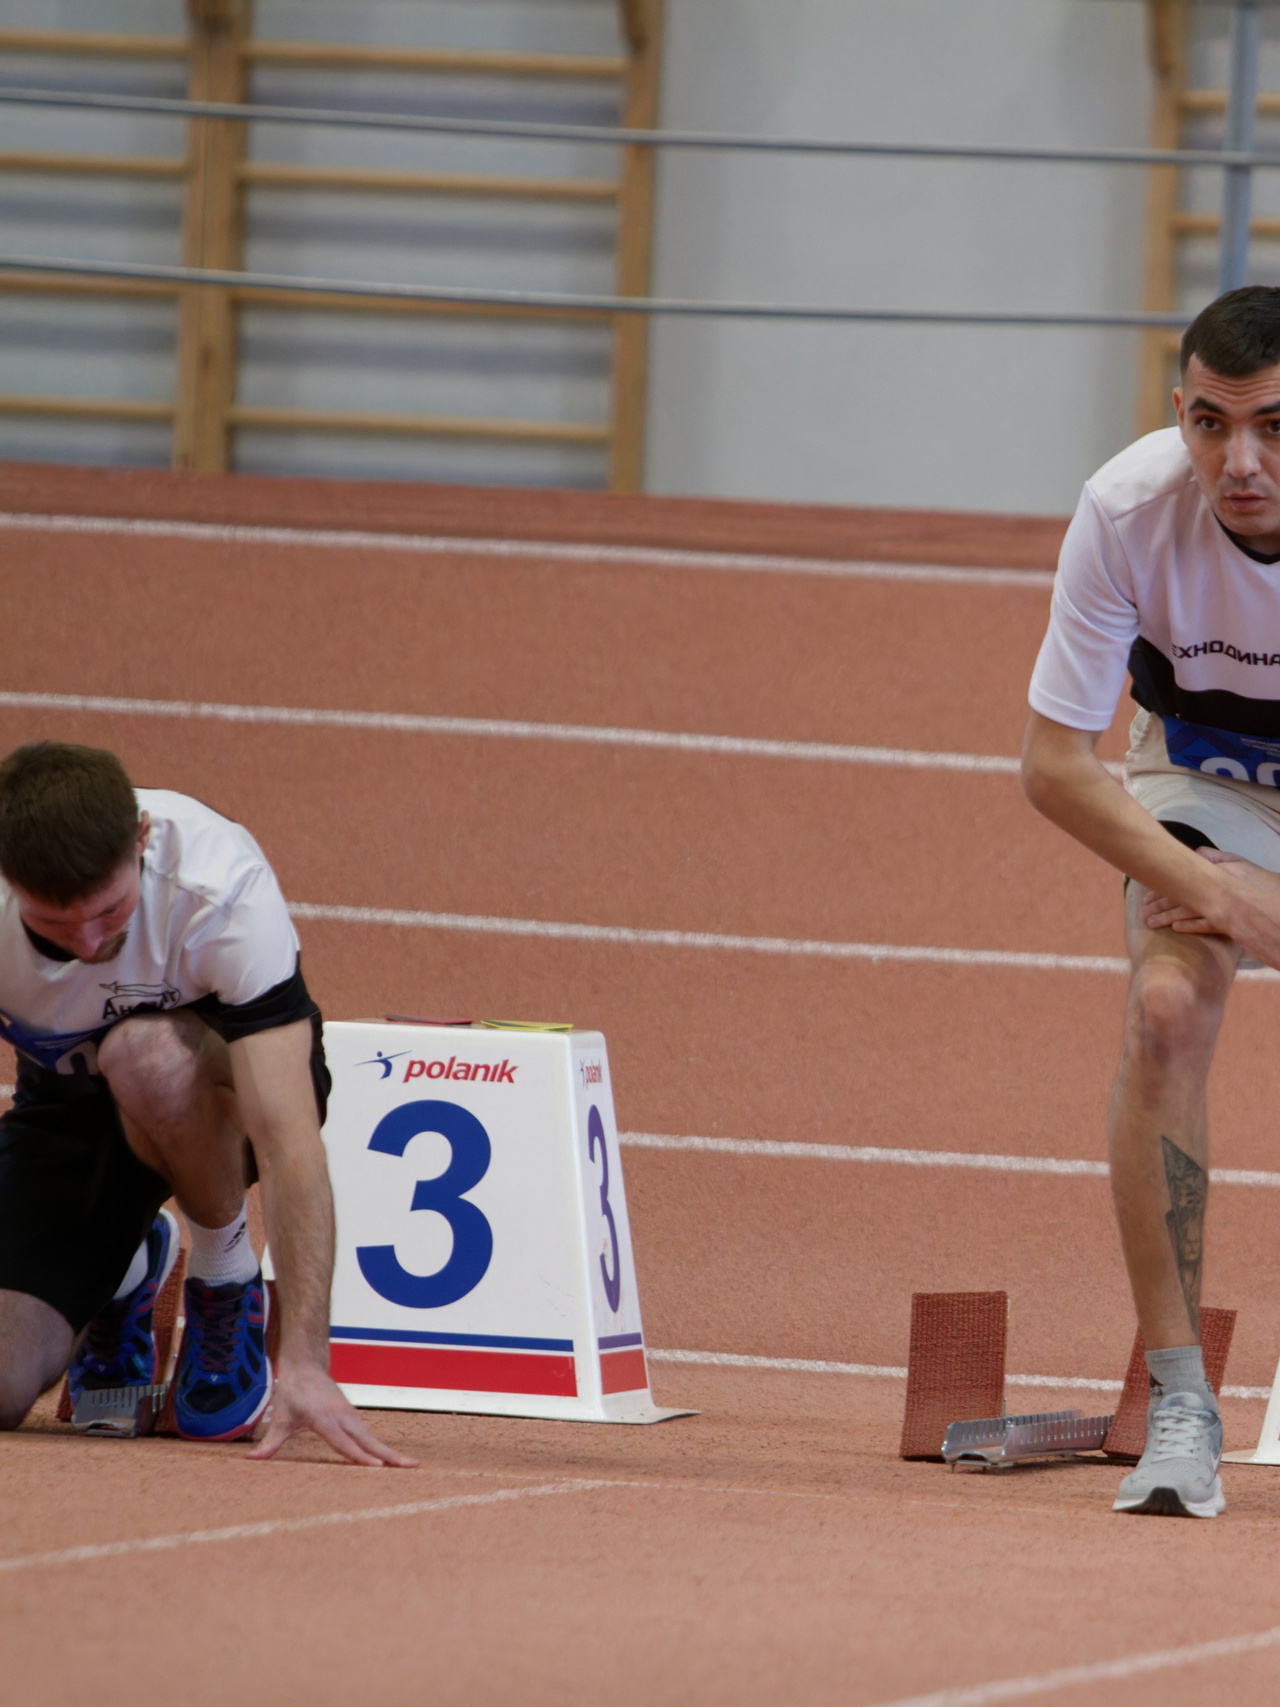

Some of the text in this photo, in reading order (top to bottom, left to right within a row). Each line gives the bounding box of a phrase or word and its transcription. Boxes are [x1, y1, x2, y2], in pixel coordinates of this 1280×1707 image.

[402, 1056, 519, 1084] polanik
[356, 1099, 493, 1309] 3
[587, 1104, 621, 1314] 3
